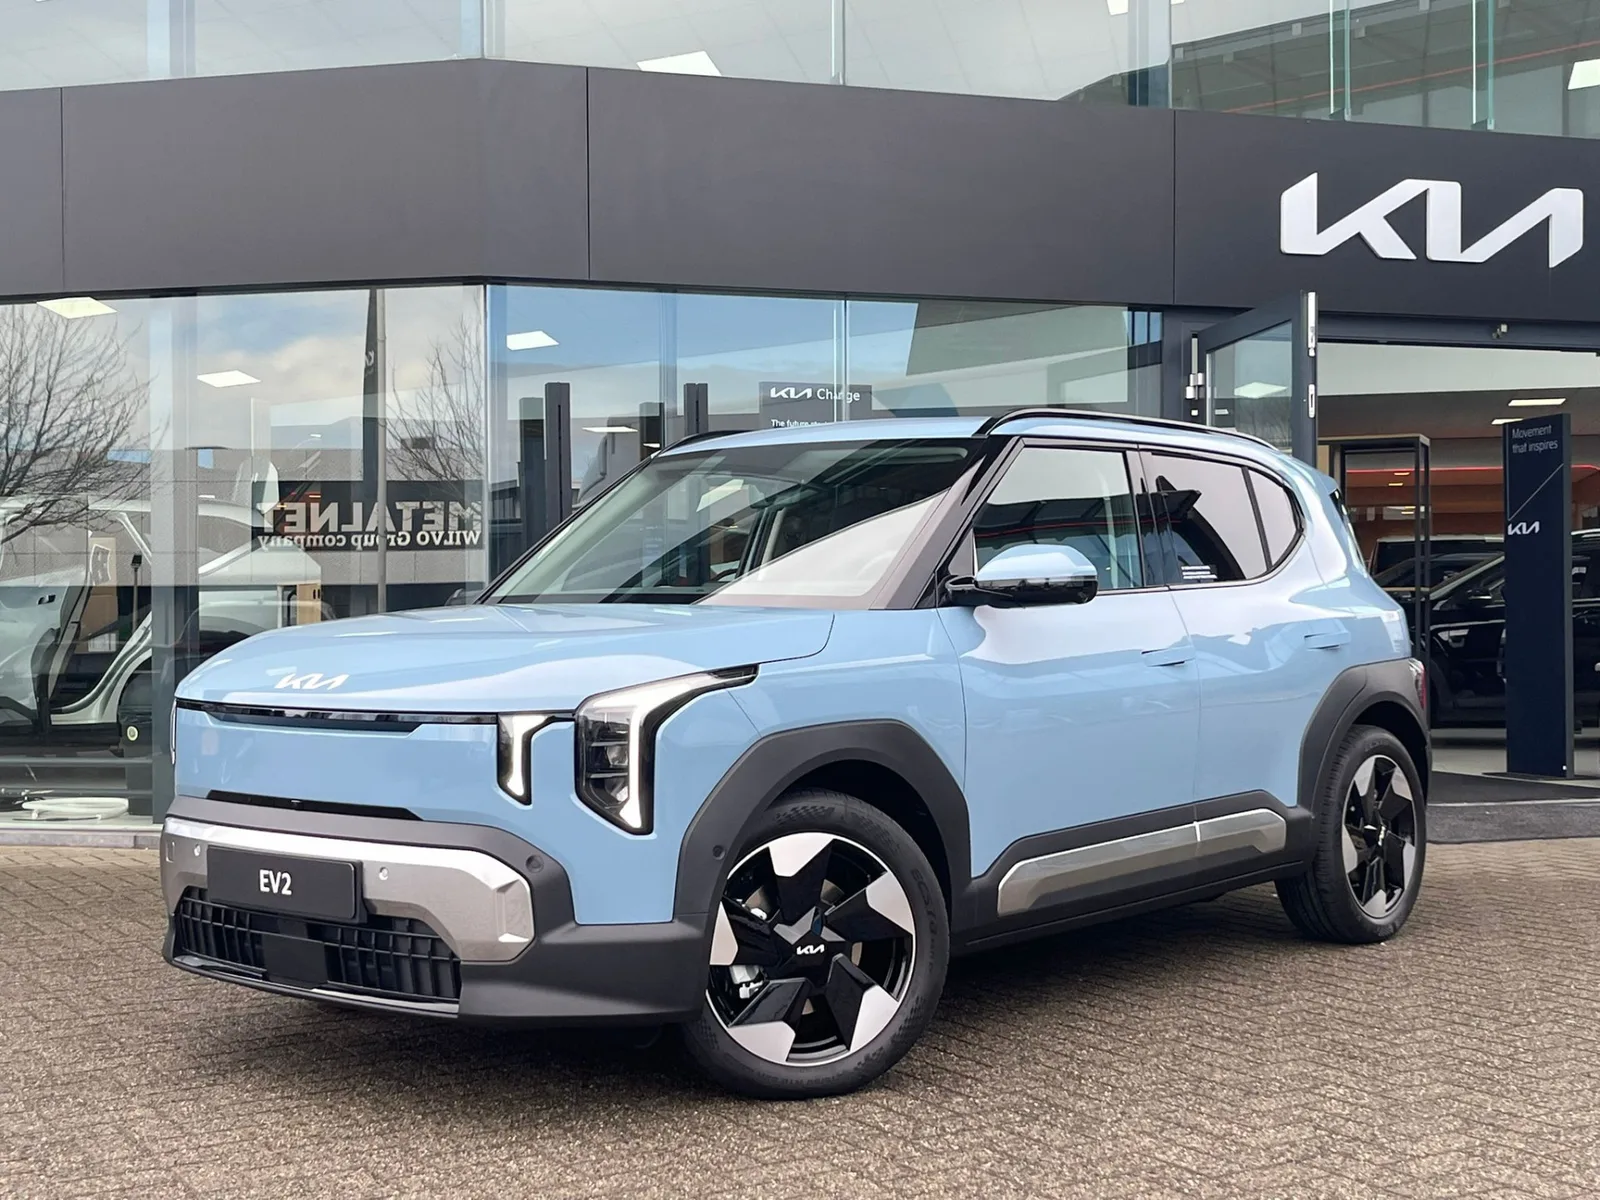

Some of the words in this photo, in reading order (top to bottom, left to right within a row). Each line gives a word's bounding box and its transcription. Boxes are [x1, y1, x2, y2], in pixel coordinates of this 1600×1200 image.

[1280, 172, 1584, 268] KIA
[770, 387, 812, 399] KIA
[770, 419, 785, 428] The
[1512, 424, 1552, 439] Movement
[1512, 443, 1527, 454] that
[1528, 440, 1559, 454] inspires
[1507, 521, 1540, 536] KIA
[274, 673, 350, 690] KIA
[259, 869, 293, 896] EV2
[796, 943, 826, 955] KIA
